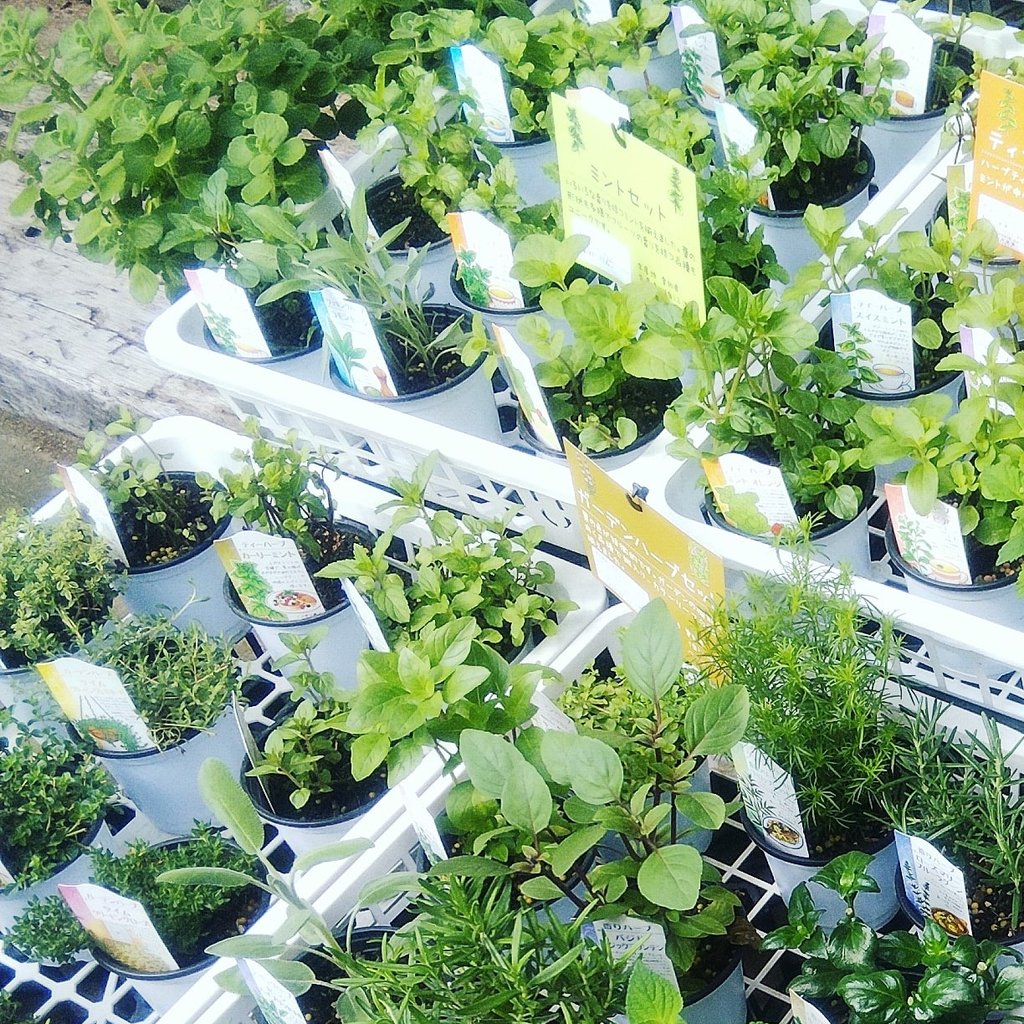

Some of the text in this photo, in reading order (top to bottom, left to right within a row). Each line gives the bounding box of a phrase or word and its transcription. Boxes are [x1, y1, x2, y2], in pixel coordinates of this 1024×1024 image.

[590, 163, 666, 221] ミントセット
